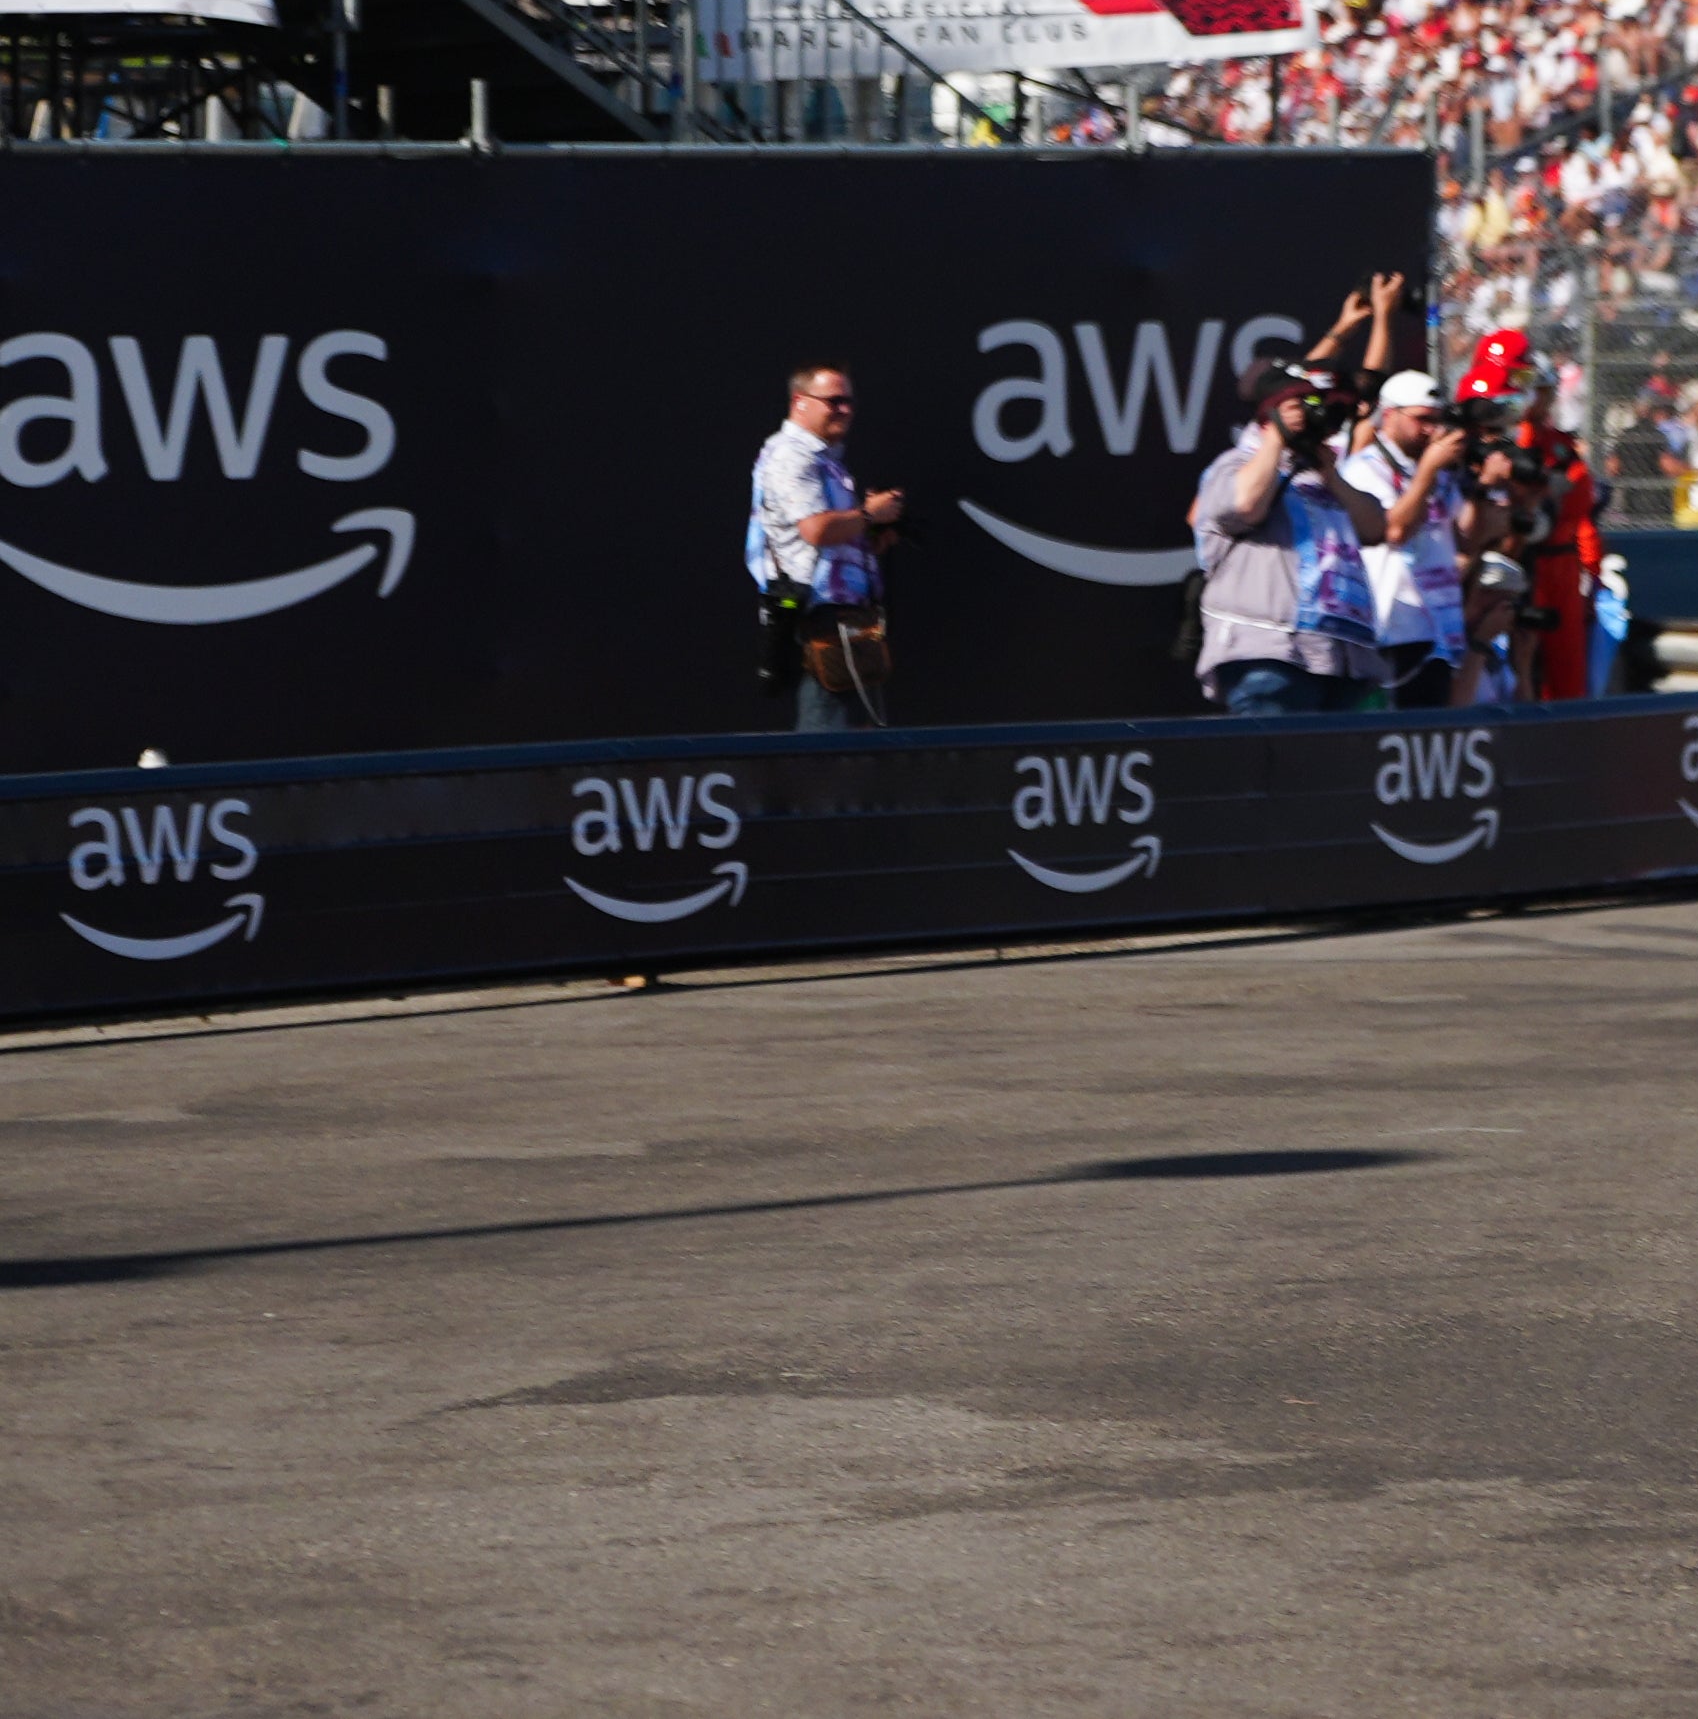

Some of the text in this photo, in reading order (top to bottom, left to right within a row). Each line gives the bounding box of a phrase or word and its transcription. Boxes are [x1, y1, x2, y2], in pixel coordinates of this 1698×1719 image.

[0, 330, 396, 487] aws
[1013, 751, 1154, 831] aws
[1376, 729, 1494, 806] aws
[69, 798, 258, 890] aws
[571, 772, 740, 856] aws
